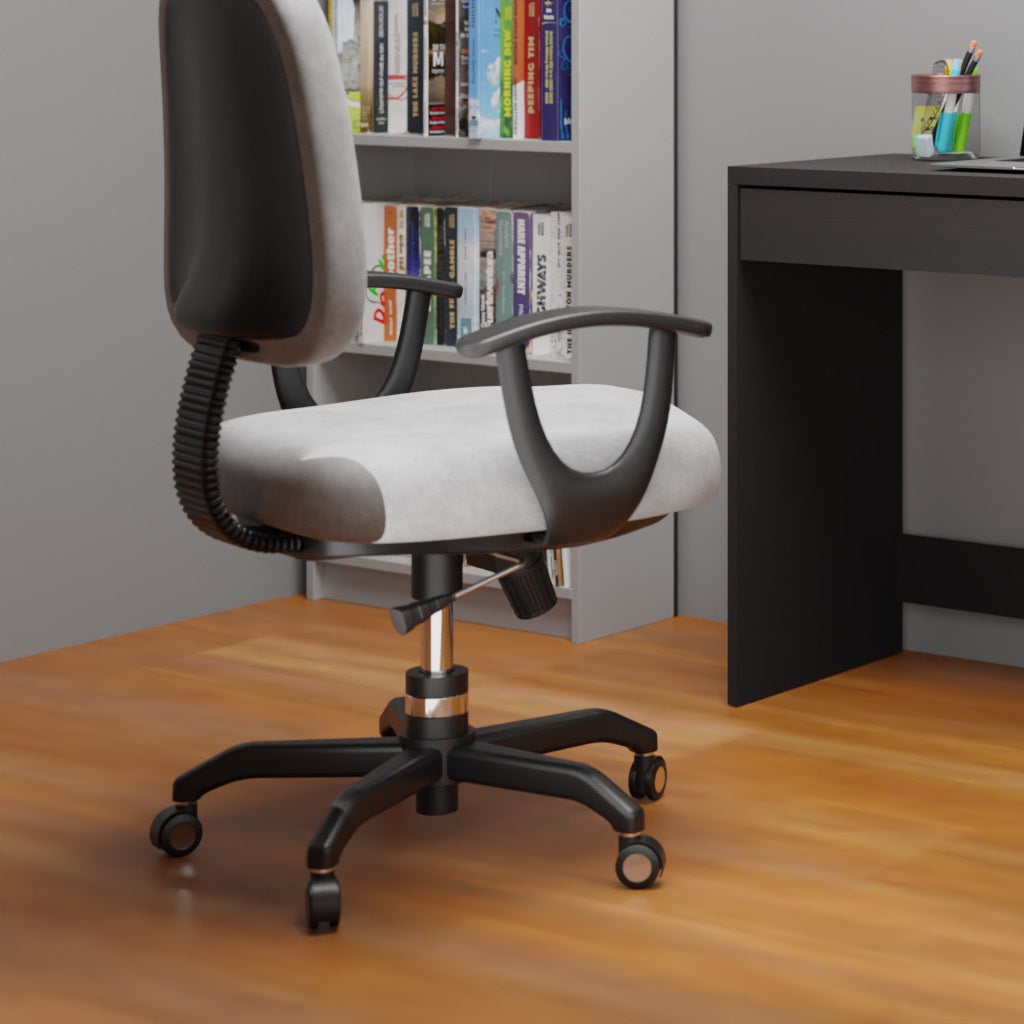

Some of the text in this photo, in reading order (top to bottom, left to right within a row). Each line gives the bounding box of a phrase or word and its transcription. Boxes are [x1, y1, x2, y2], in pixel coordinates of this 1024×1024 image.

[503, 28, 512, 118] MORNING DEW
[527, 36, 535, 114] PEEPING TIM
[516, 218, 526, 244] HARE
[516, 245, 526, 296] APPARENT
[537, 254, 547, 312] GHWAYS
